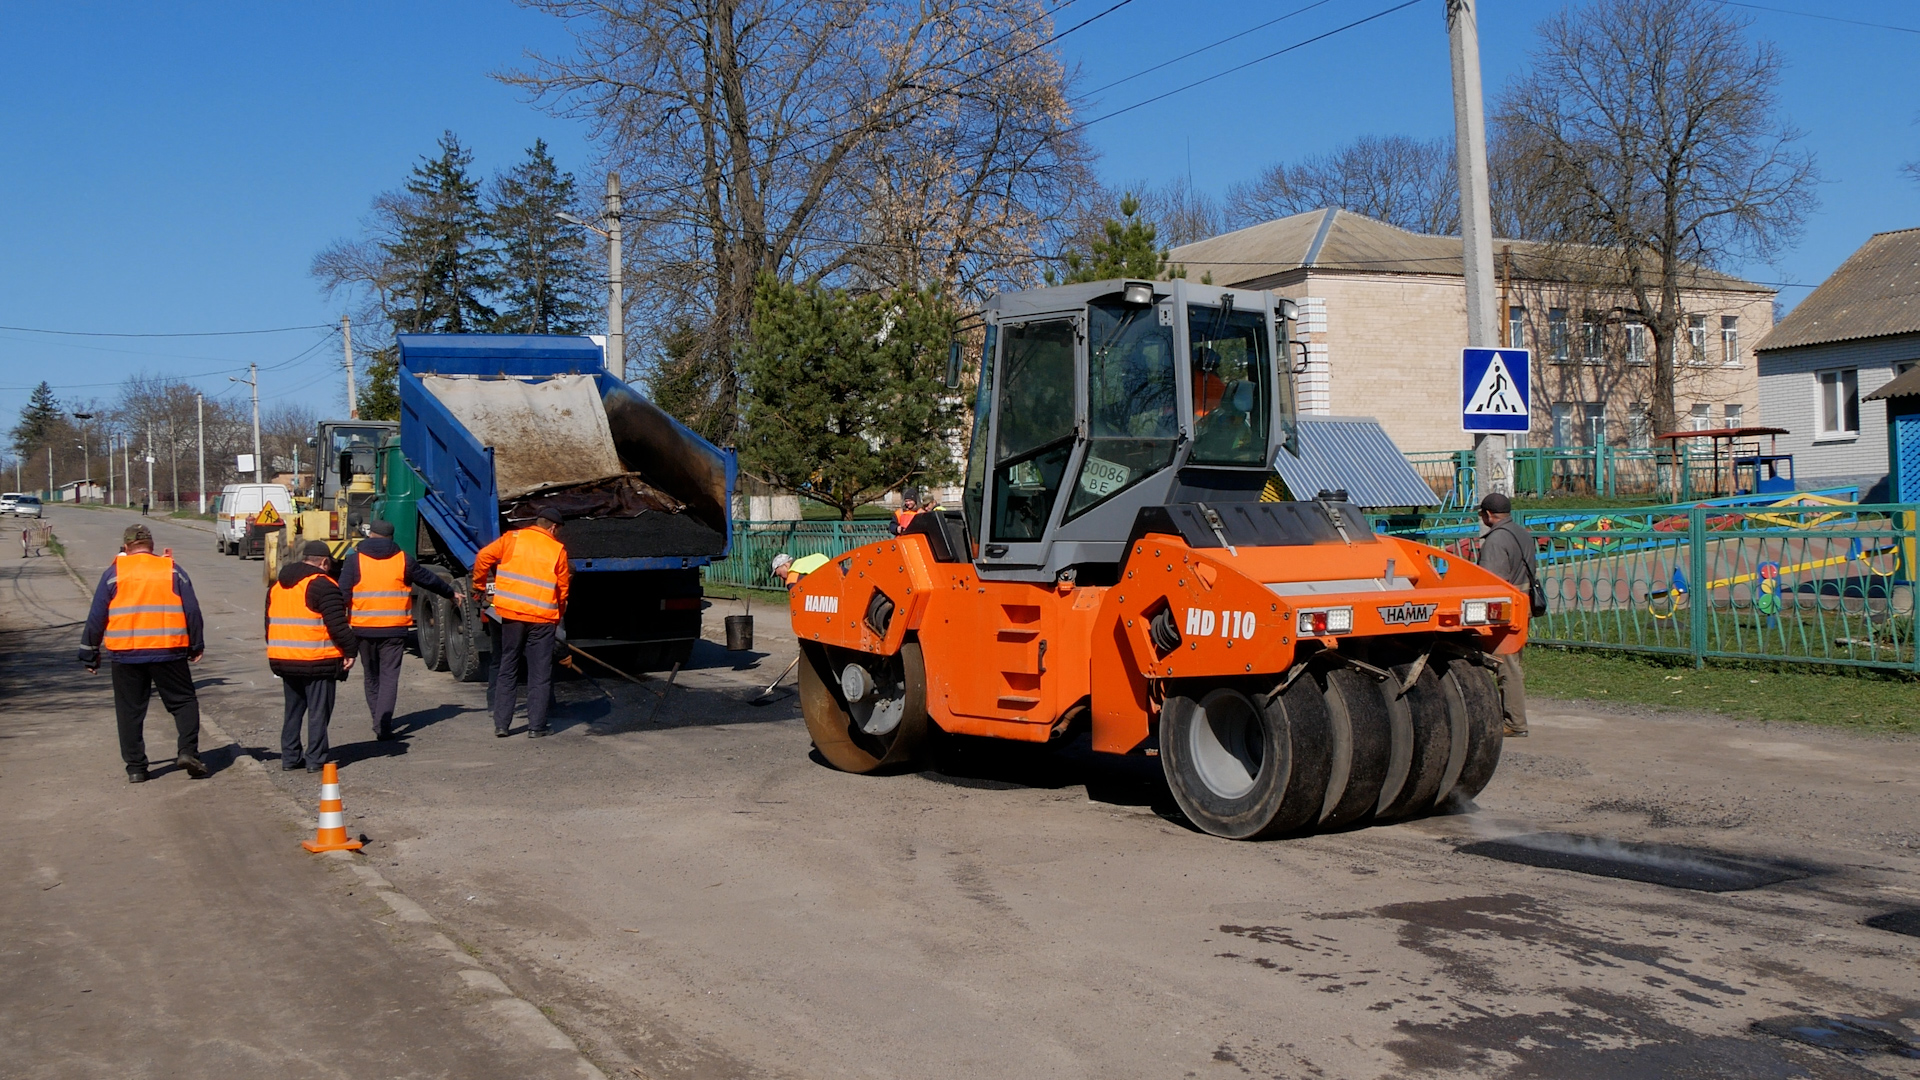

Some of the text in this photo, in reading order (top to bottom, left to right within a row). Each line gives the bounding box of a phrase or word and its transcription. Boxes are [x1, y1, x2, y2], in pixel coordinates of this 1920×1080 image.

[1090, 479, 1109, 493] BE
[805, 595, 838, 613] HAMM
[1387, 606, 1427, 622] HAMM
[1186, 608, 1256, 640] HD 110
